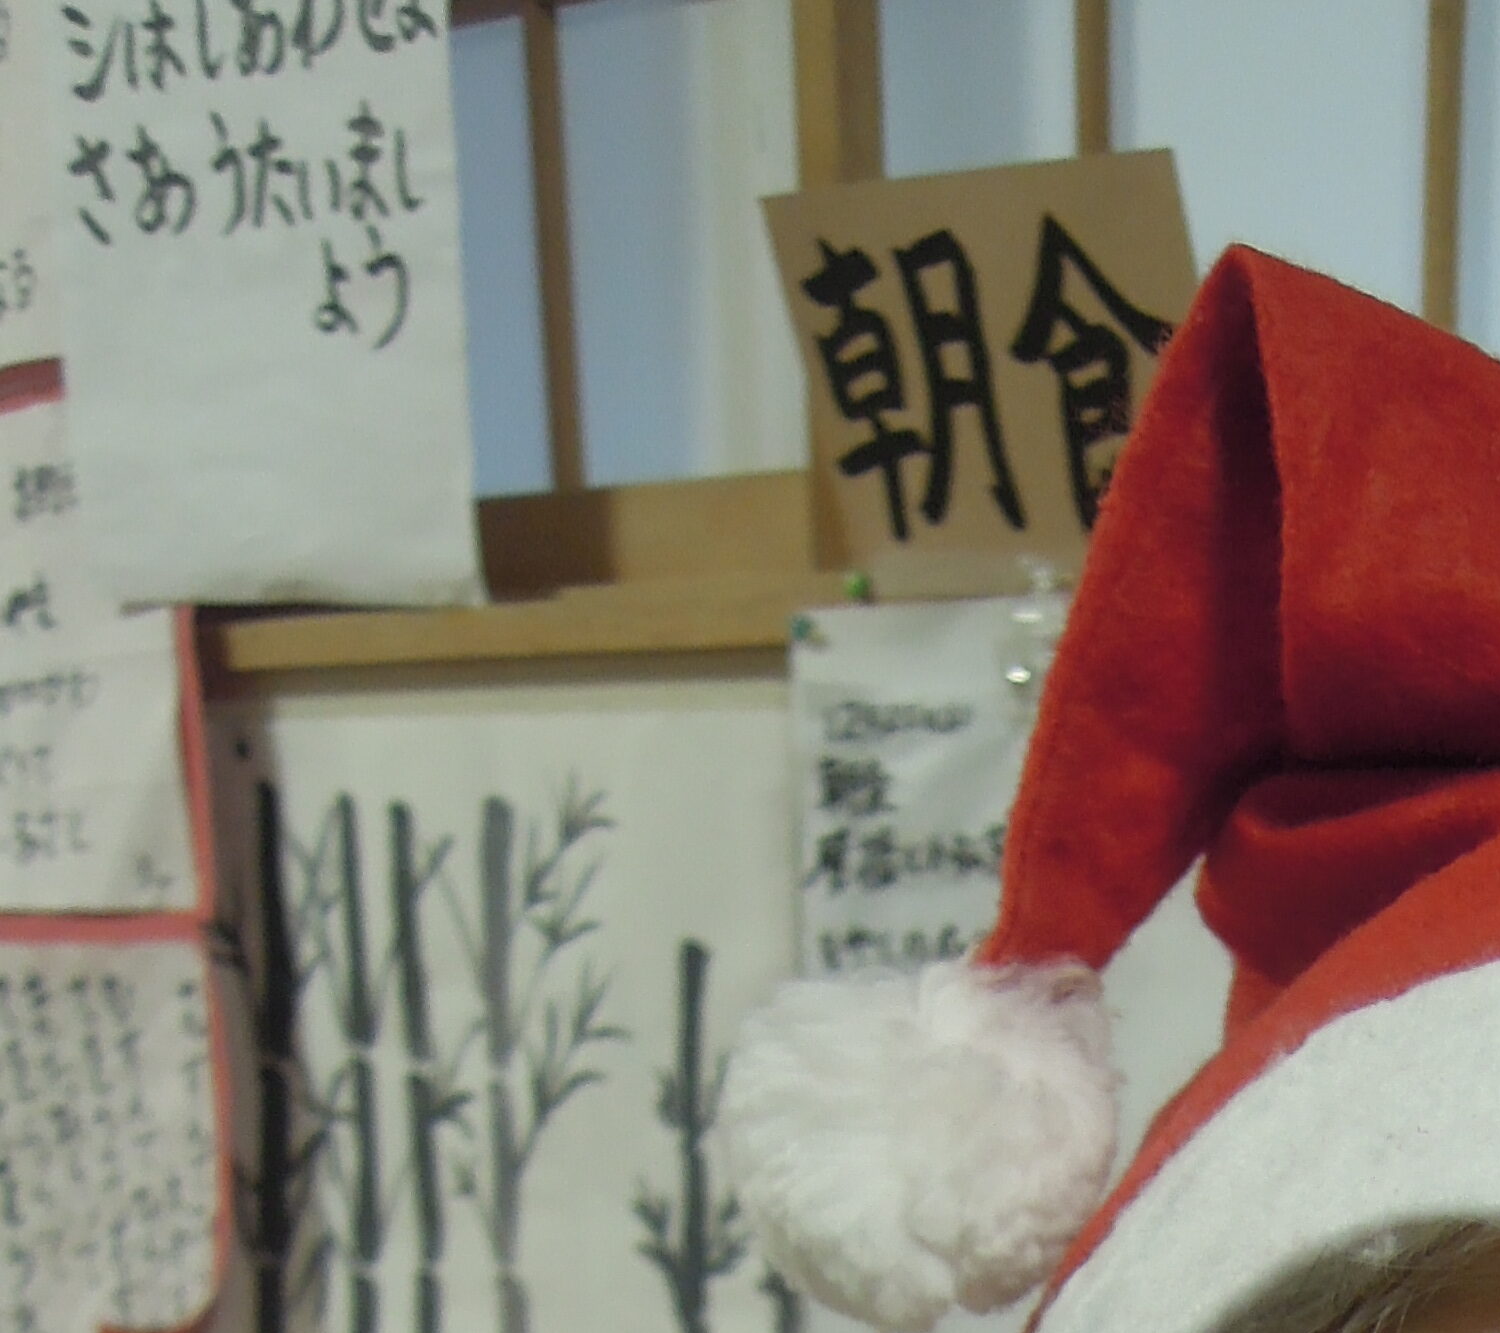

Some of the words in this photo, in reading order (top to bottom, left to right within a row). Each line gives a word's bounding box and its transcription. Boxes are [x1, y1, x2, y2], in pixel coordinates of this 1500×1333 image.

[68, 100, 424, 246] さあうたいまし
[314, 224, 410, 350] よう
[800, 210, 1180, 545] 朝食
